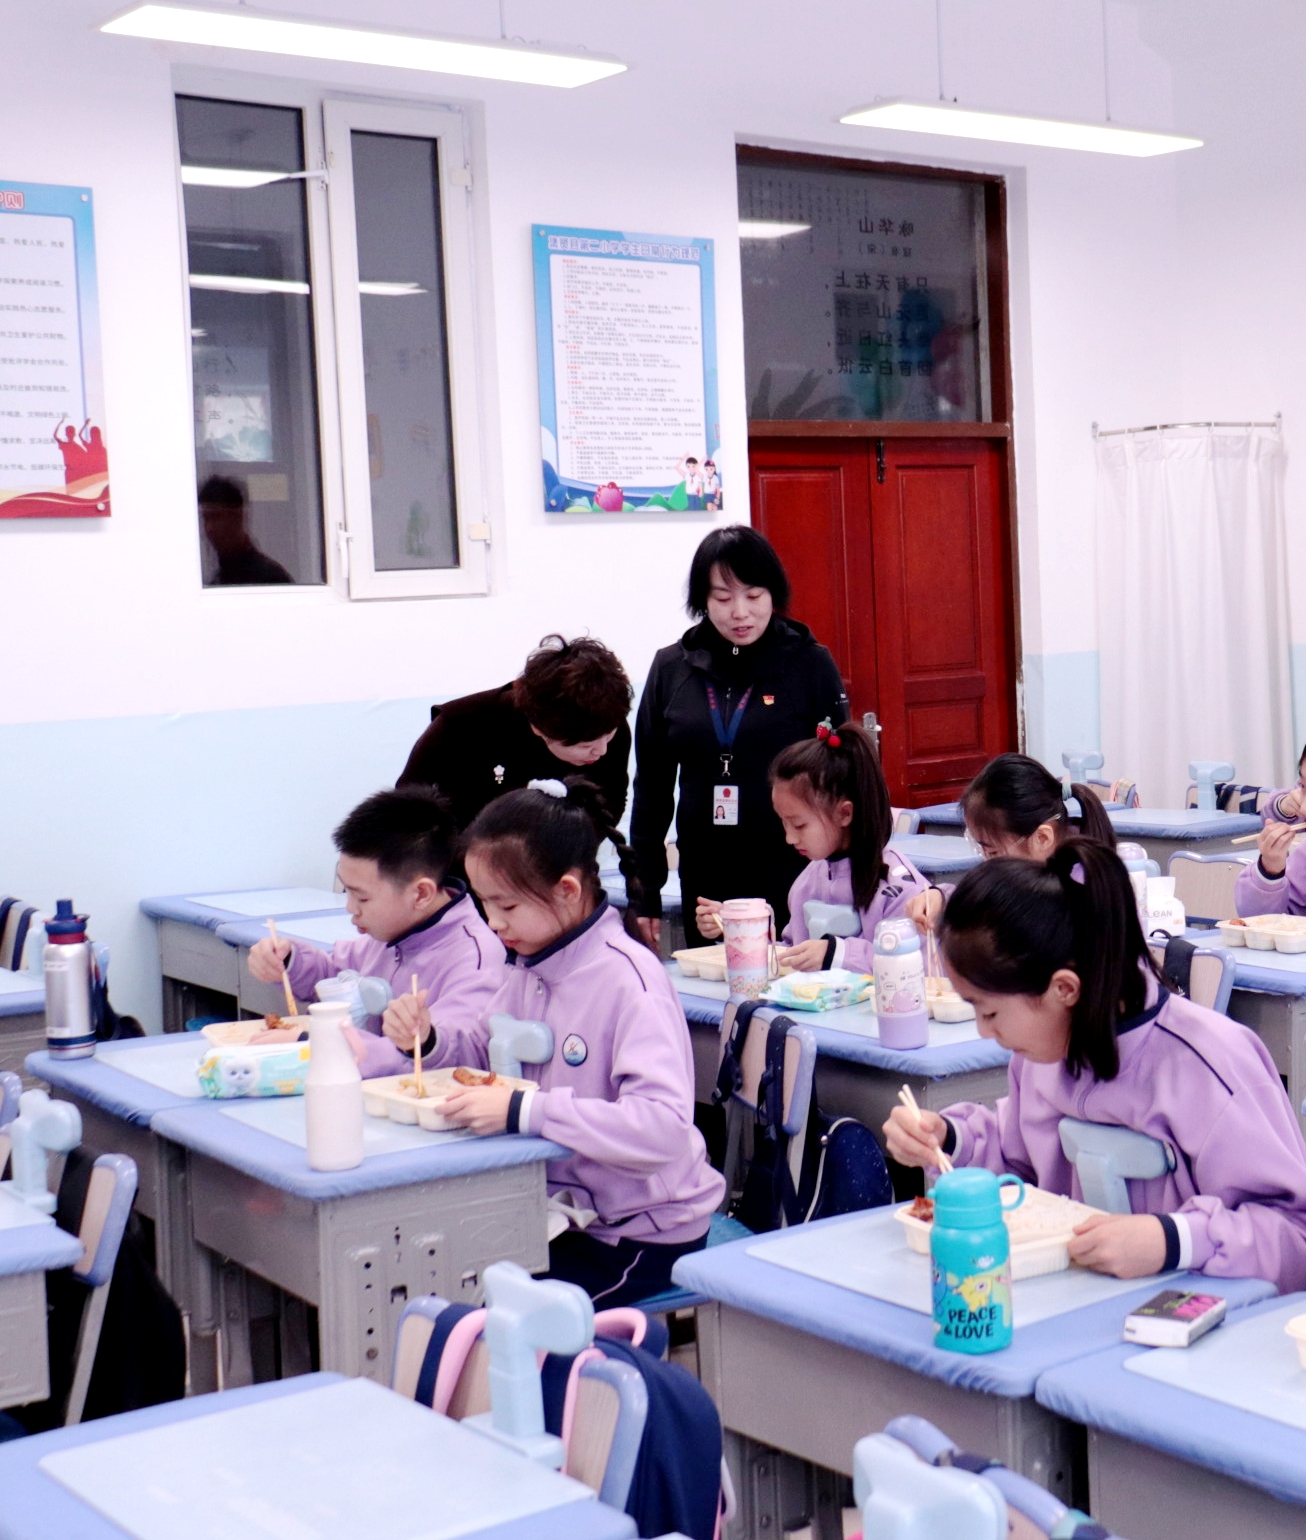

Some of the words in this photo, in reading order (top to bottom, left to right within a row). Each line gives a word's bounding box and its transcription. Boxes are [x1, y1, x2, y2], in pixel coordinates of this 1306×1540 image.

[948, 1305, 997, 1324] PEACE
[944, 1324, 952, 1336] &
[955, 1322, 993, 1339] LOVE
